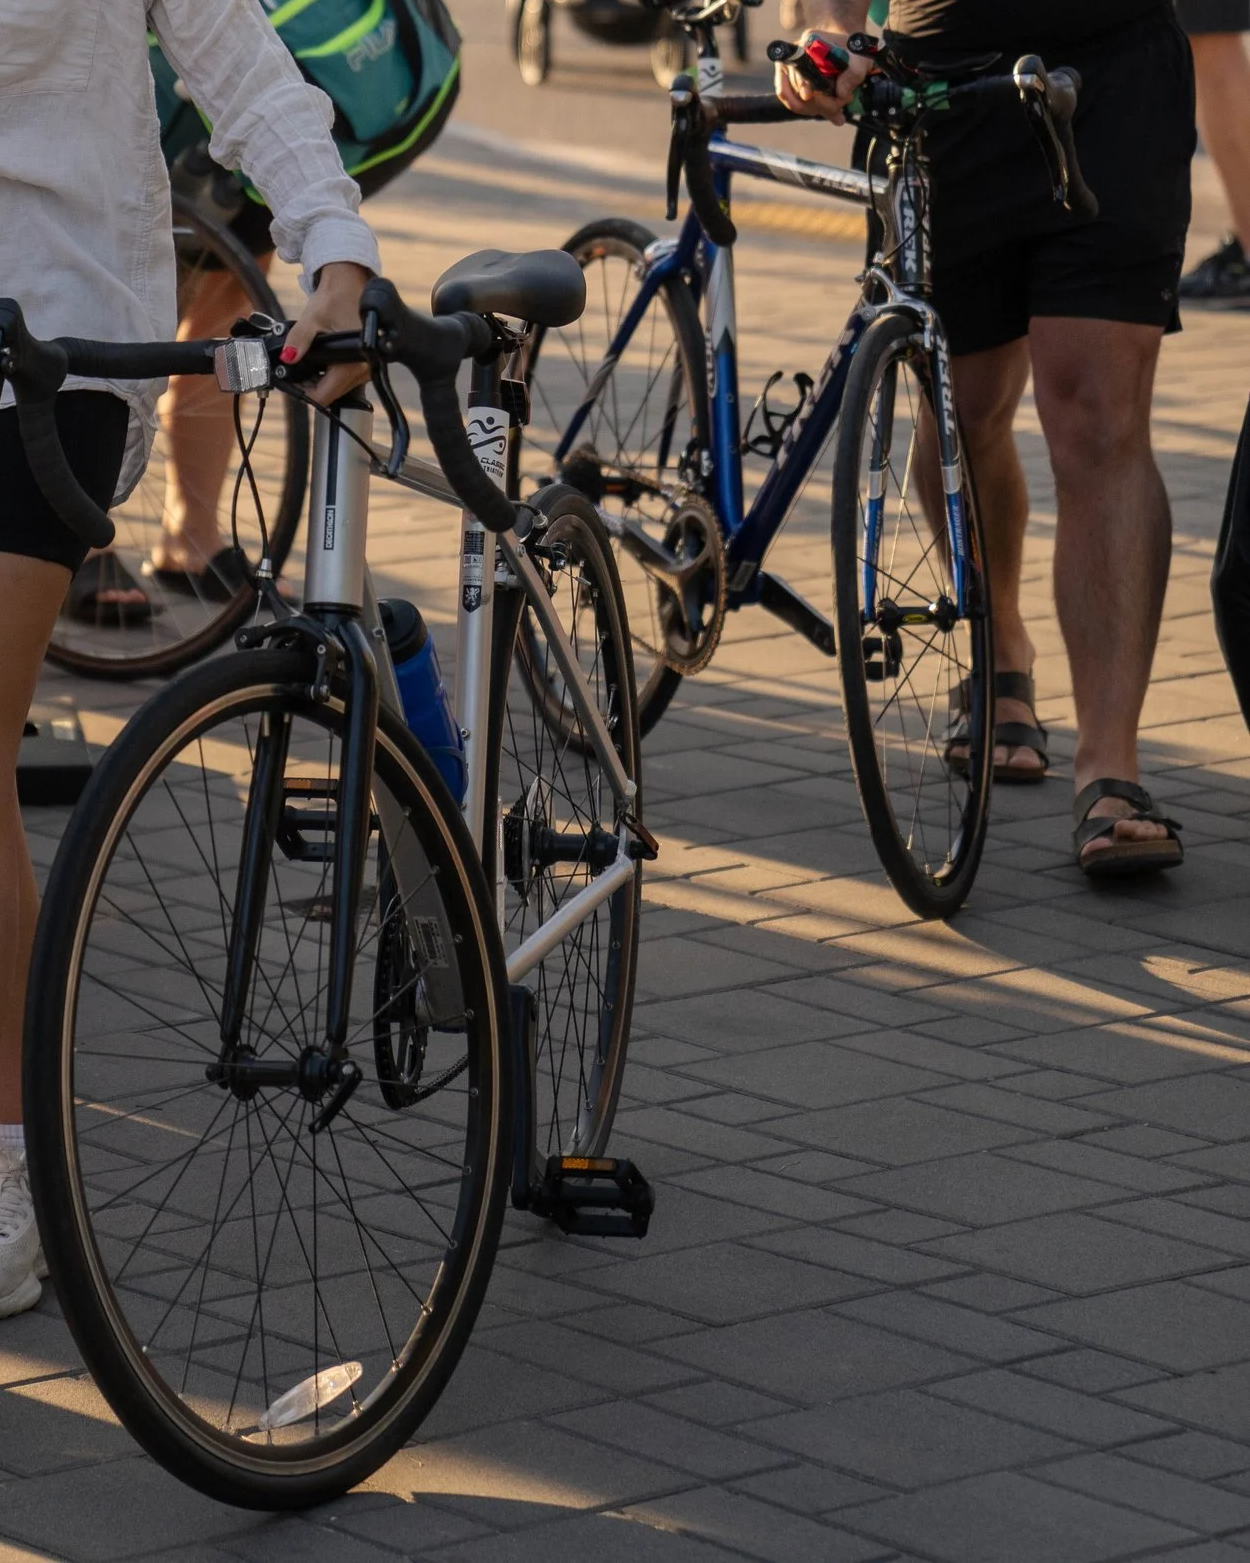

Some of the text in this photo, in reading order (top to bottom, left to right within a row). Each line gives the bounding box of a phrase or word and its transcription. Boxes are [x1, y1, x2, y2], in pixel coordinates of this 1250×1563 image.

[936, 332, 955, 436] TREK
[325, 509, 334, 548] DECATHLON
[957, 505, 971, 557] BONTRAGER
